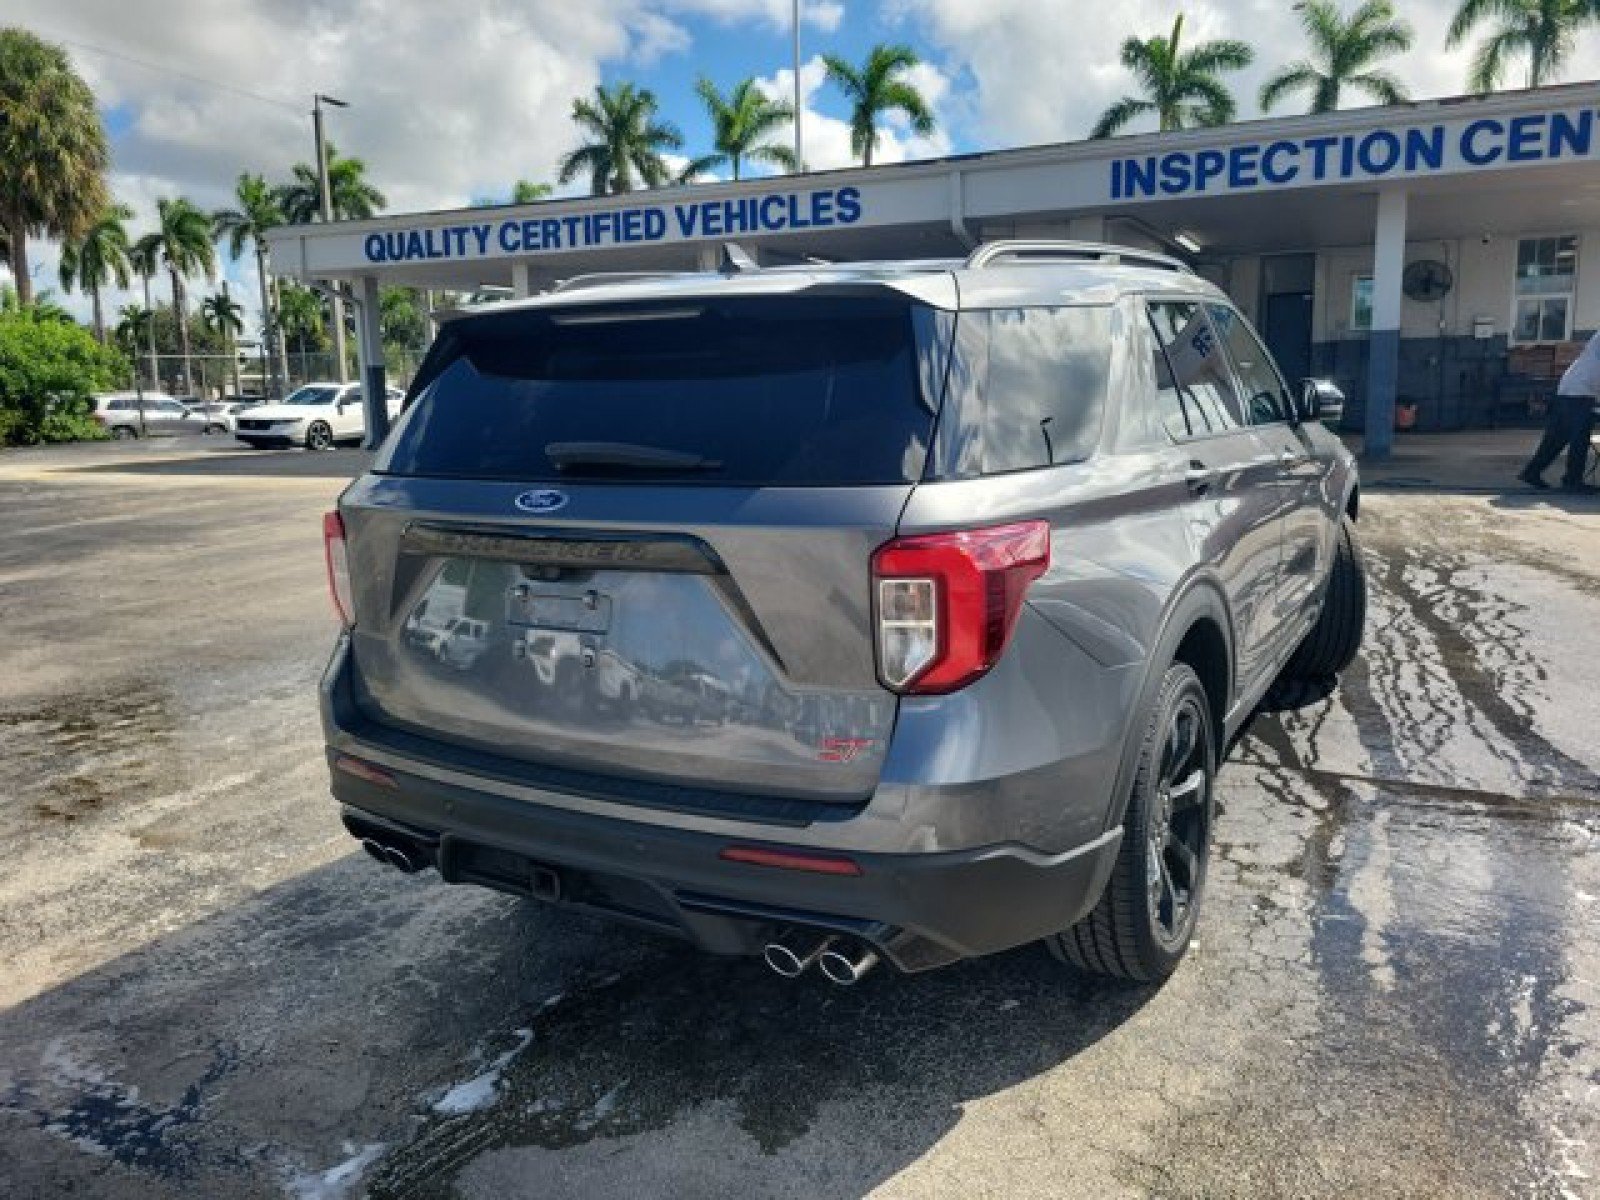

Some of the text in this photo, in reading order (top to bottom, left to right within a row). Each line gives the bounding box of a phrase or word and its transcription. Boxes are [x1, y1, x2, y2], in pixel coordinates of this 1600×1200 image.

[1110, 109, 1600, 199] INSPECTION CEN
[364, 187, 862, 262] QUALITY CERTIFIED VEHICLES
